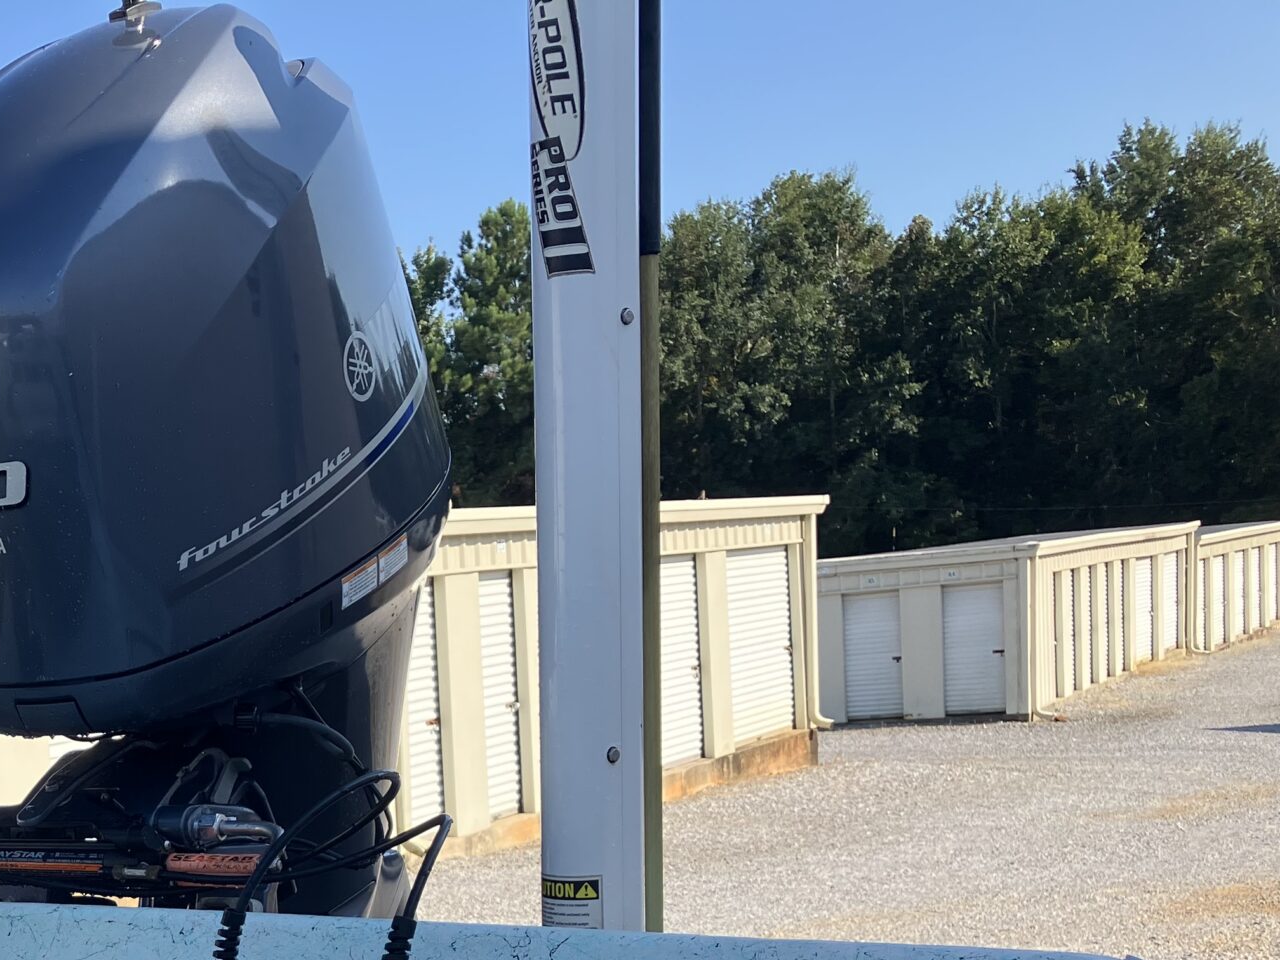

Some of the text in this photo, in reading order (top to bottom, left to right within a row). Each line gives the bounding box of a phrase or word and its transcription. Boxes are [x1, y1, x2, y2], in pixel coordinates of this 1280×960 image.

[531, 33, 544, 86] ANCHOR
[534, 0, 577, 116] -POLE
[531, 143, 550, 225] SERIES
[539, 136, 579, 222] PRO
